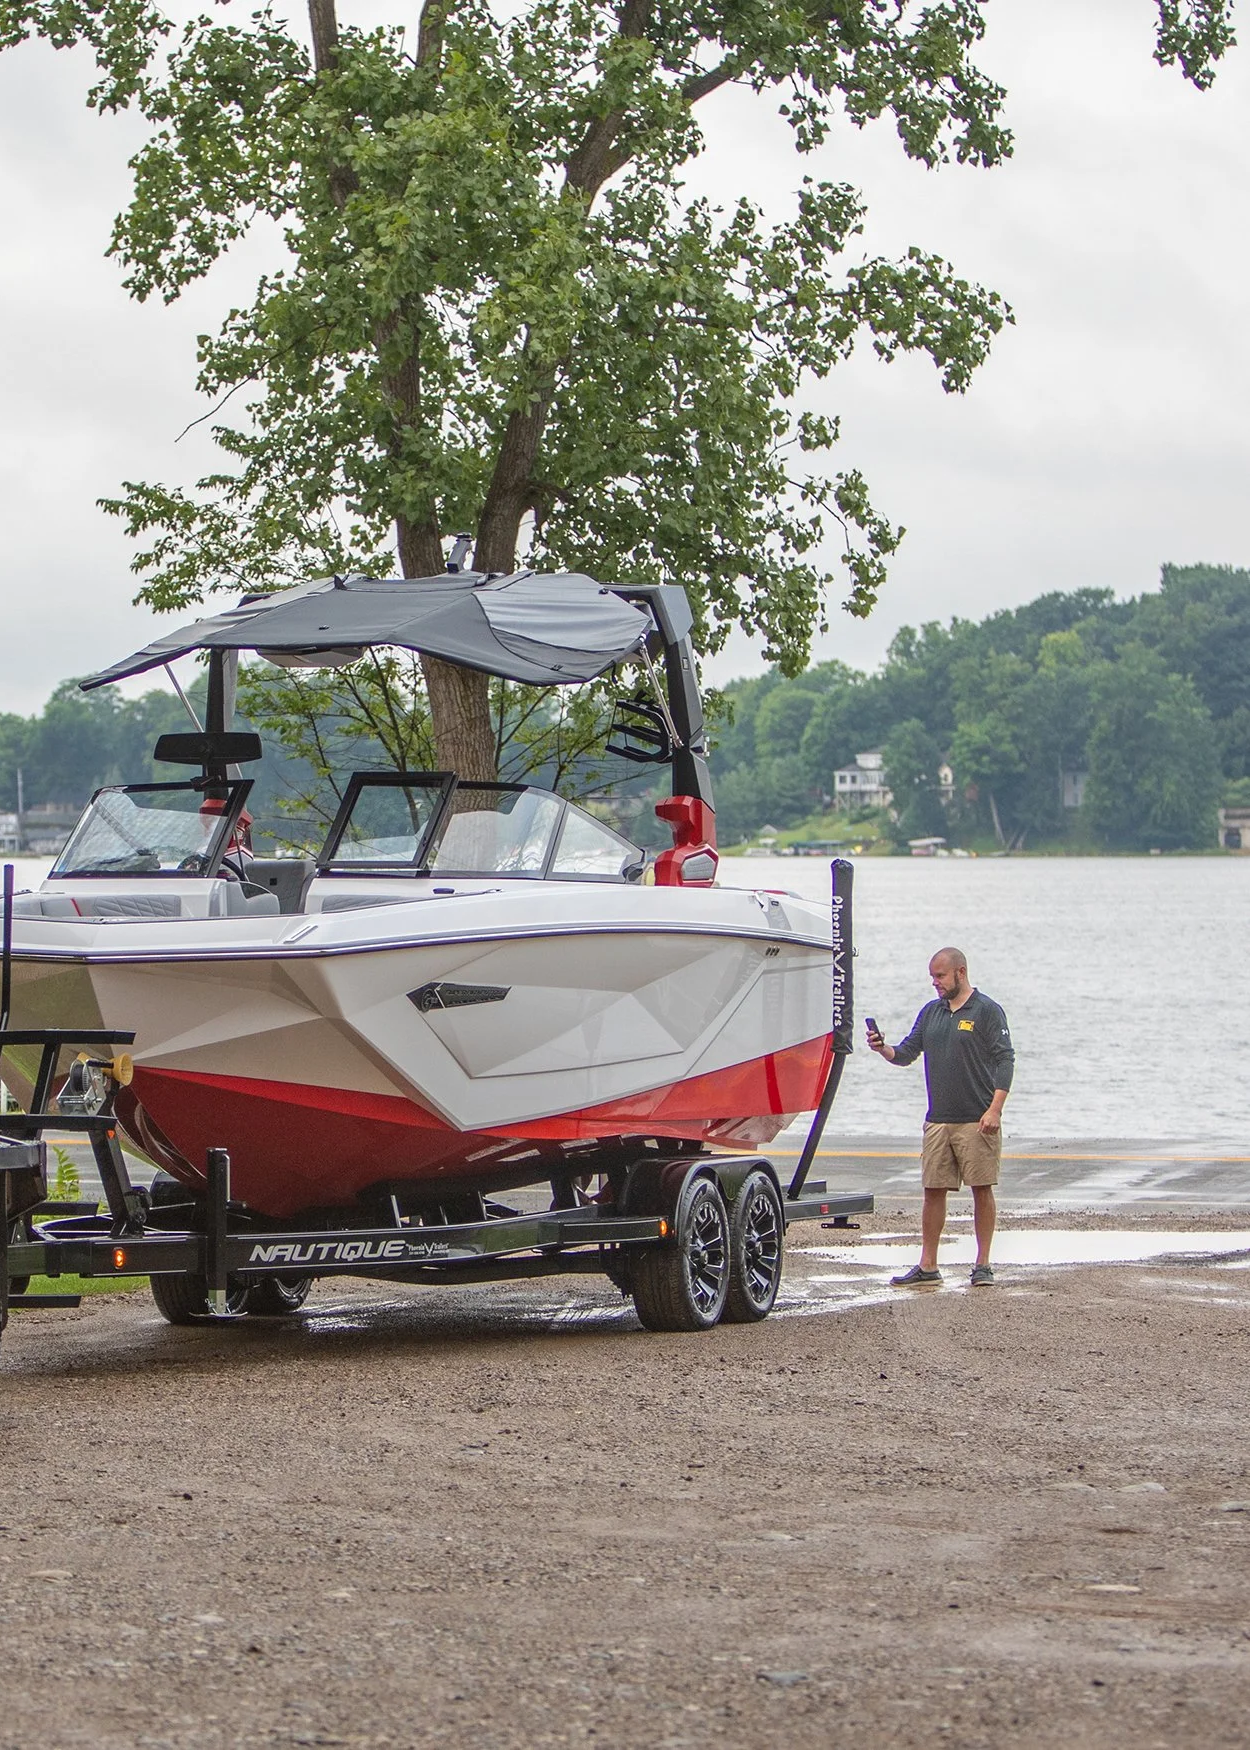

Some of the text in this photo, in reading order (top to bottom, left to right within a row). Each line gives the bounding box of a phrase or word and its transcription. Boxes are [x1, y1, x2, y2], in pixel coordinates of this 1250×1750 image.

[832, 895, 846, 1027] Phoenix Trailers
[249, 1239, 406, 1262] NAUTIQUE
